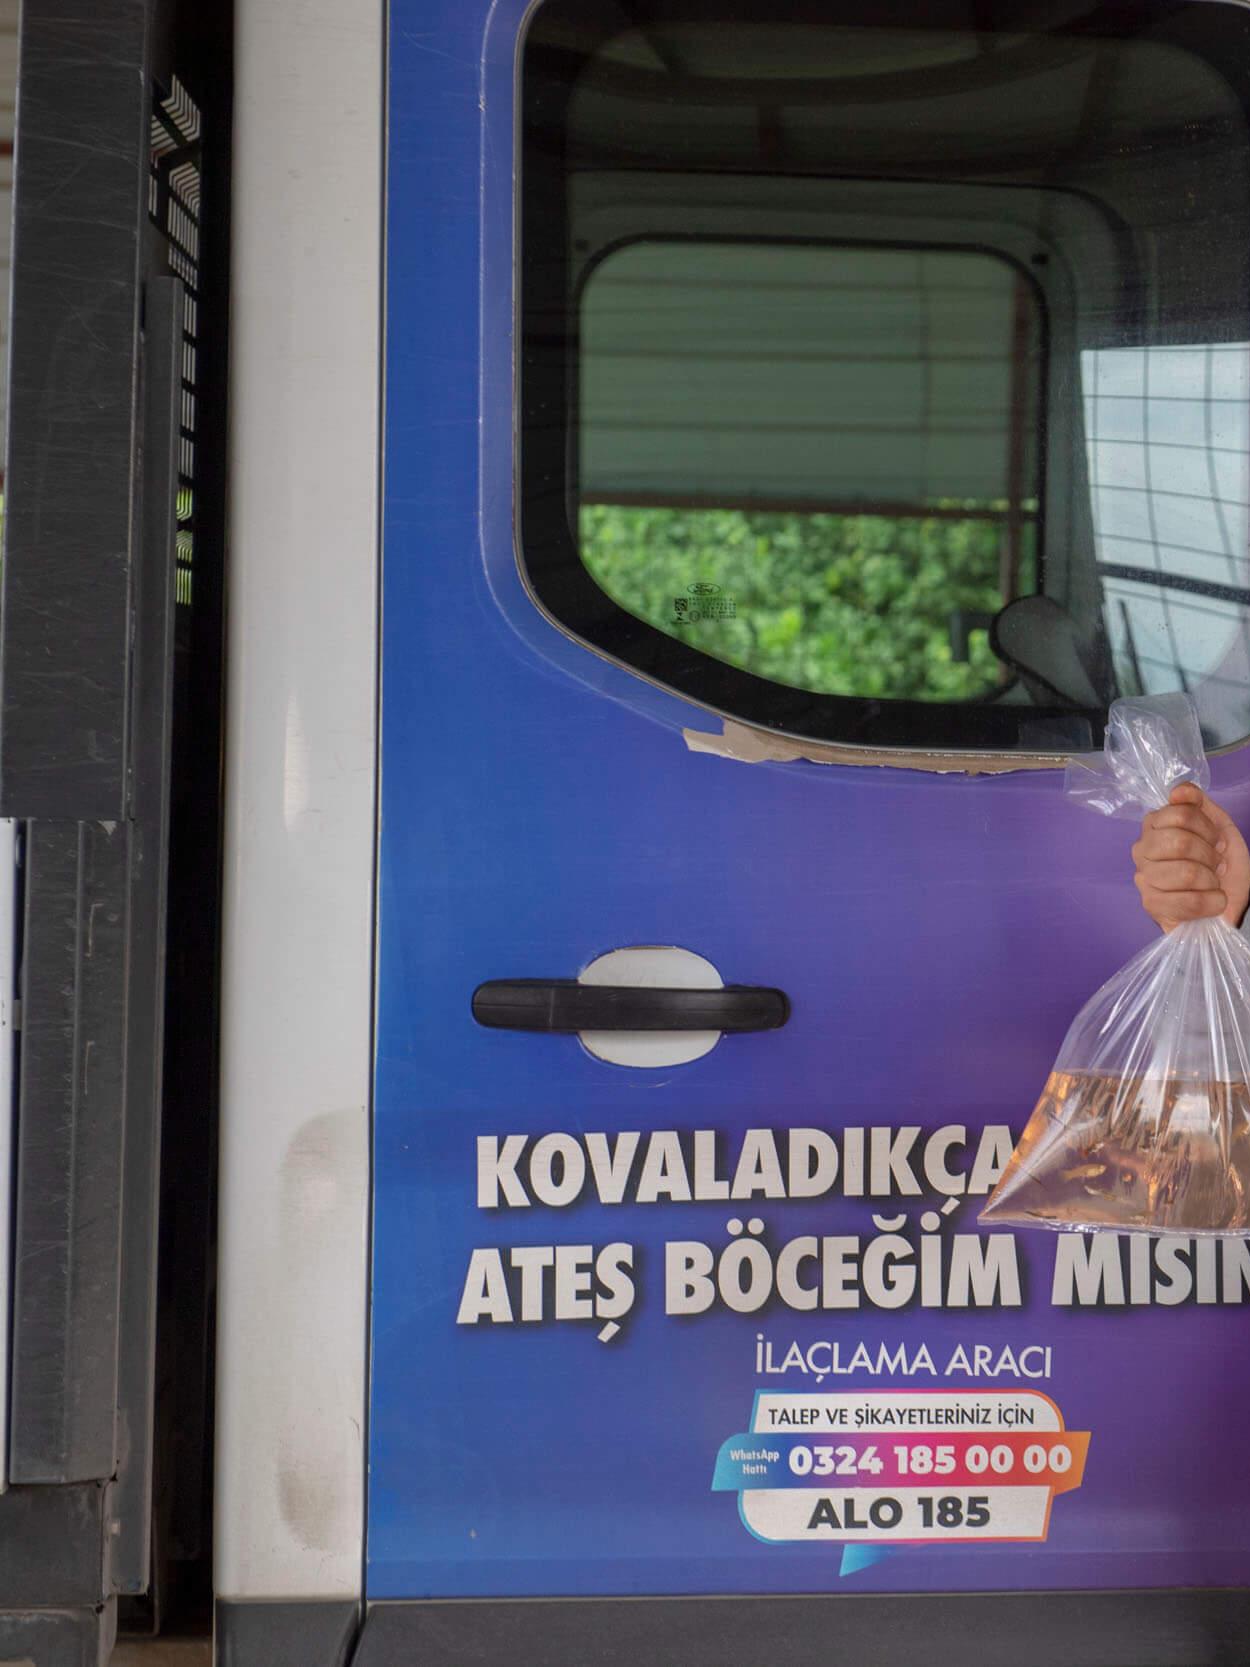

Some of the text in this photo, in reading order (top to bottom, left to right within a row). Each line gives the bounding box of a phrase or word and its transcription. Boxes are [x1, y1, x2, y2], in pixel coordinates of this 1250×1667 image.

[477, 1124, 1014, 1216] KOVALADIKÇA
[457, 1242, 635, 1343] ATEŞ
[665, 1211, 1022, 1315] BÖCEĞİM
[755, 1333, 1052, 1383] İLAÇLAMA ARACI
[768, 1403, 1034, 1428] TALEP VE ŞİKAYETLERİNİZ İÇİN
[730, 1448, 780, 1463] WhatsApp
[788, 1444, 1072, 1476] 0324 185 00 00
[807, 1496, 991, 1530] ALO 185
